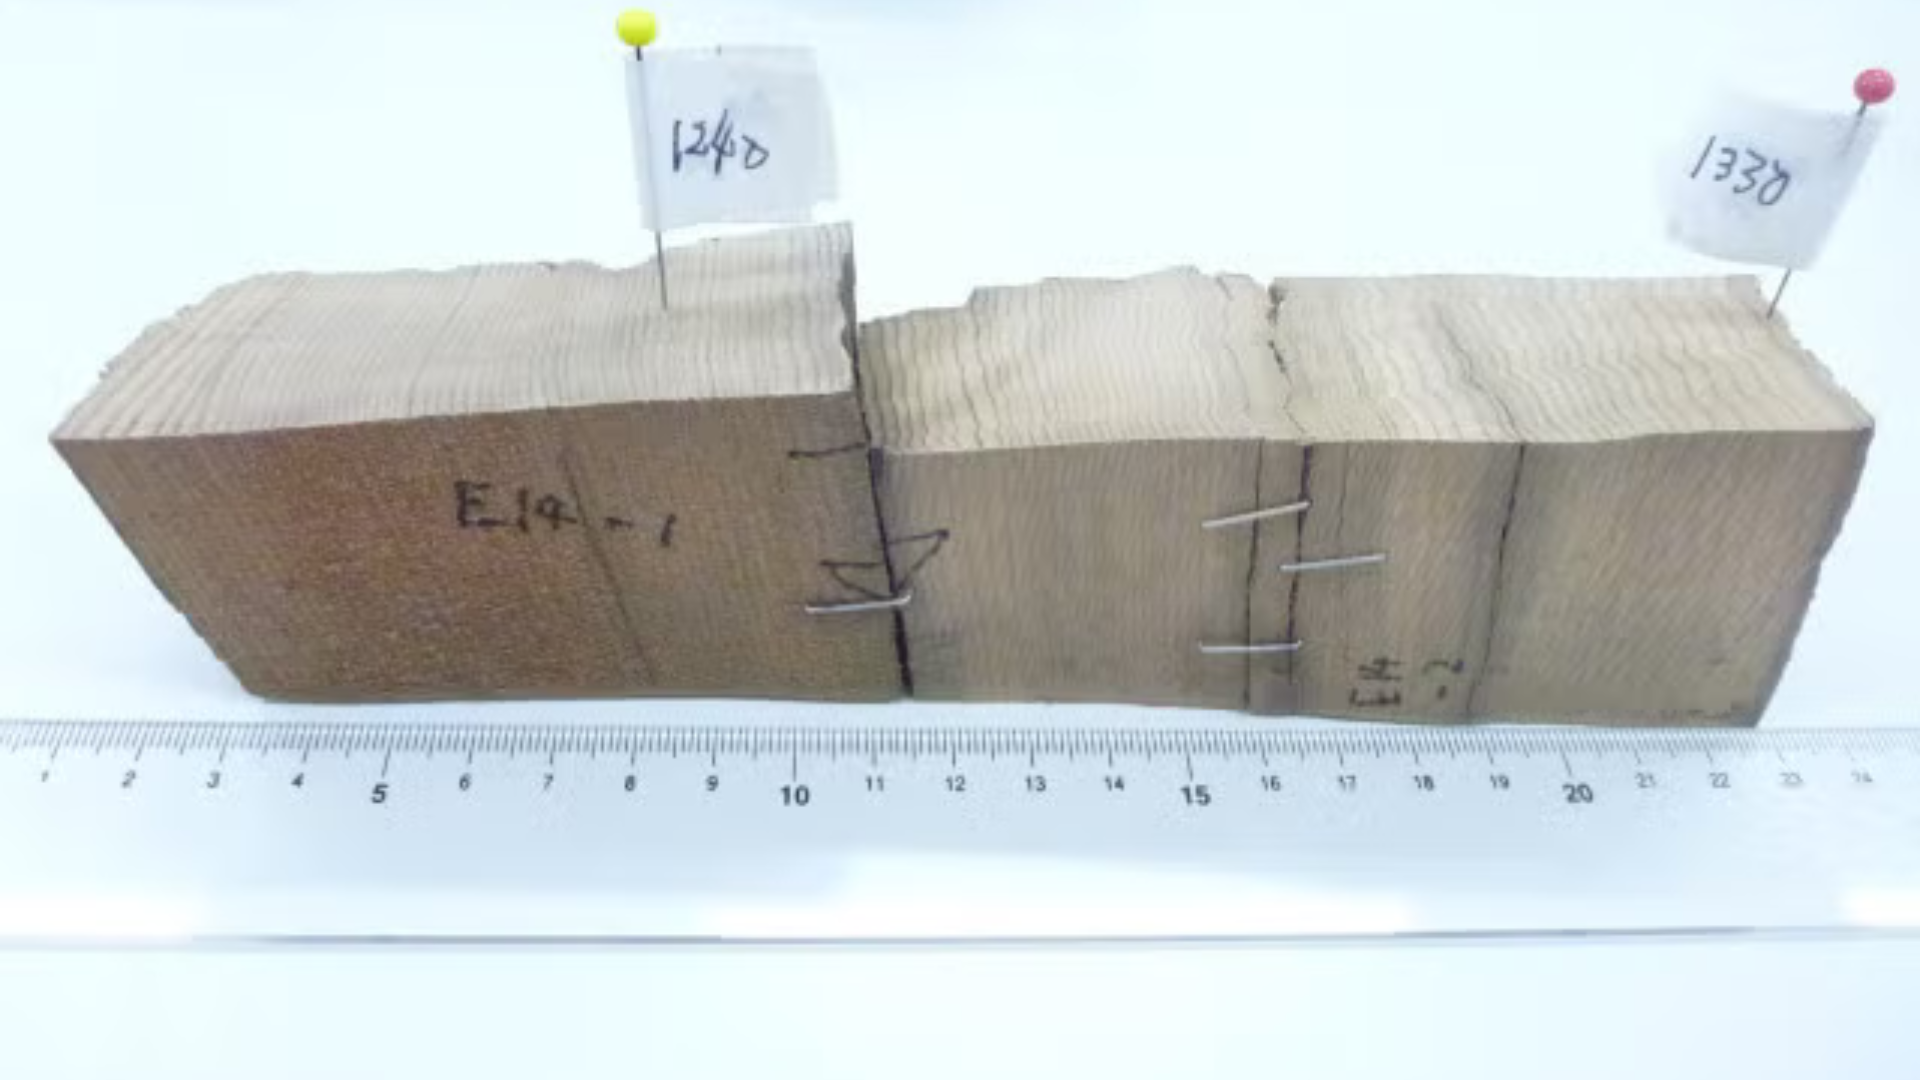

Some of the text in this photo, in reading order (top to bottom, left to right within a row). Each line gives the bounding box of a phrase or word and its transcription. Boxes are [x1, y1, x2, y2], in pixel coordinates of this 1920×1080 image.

[121, 770, 136, 789] 2
[206, 771, 221, 789] 3
[291, 772, 305, 788] 4
[370, 782, 389, 804] 5
[459, 773, 473, 791] 6
[543, 773, 556, 790] 7
[624, 775, 637, 792] 8
[705, 775, 719, 792] 9
[781, 785, 810, 806] 10
[866, 775, 885, 791] 11
[946, 775, 967, 792] 12
[1025, 775, 1048, 792] 13
[1104, 775, 1127, 791] 14
[1181, 785, 1211, 806] 15
[1262, 775, 1283, 791] 16
[1337, 775, 1357, 790] 17
[1413, 775, 1436, 791] 18
[1490, 774, 1511, 789] 19
[1564, 783, 1595, 804] 20
[1635, 772, 1657, 788] 21
[1709, 772, 1732, 788] 22
